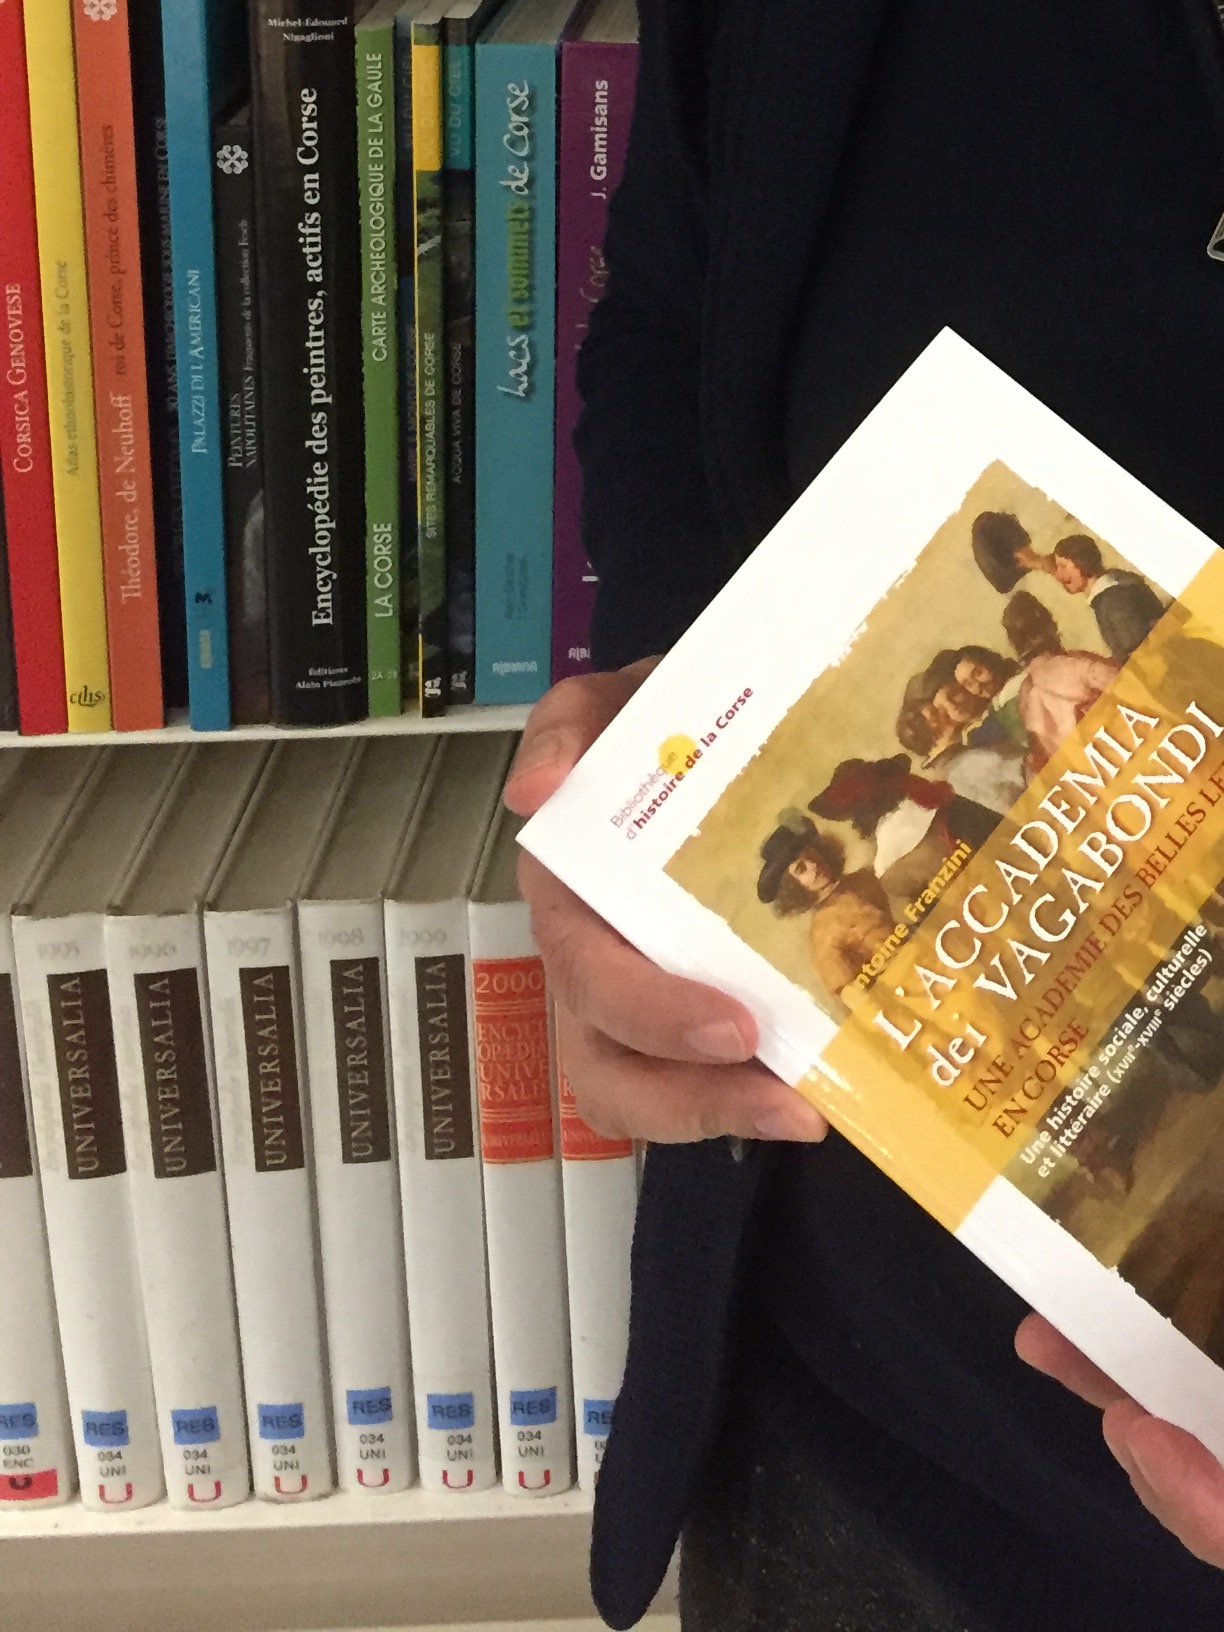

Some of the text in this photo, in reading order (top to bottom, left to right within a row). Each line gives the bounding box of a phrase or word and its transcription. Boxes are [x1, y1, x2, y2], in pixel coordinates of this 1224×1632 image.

[366, 53, 383, 109] GAULE
[367, 113, 383, 133] LA
[589, 79, 609, 200] J. Gamisans
[367, 138, 384, 158] DE
[496, 80, 530, 397] Lacs de Corse
[101, 199, 137, 502] de Neuhoff roi de prince des
[371, 311, 387, 362] CARTE
[296, 87, 337, 627] Encyclopédie des peintres, actifs en Corse
[451, 342, 462, 385] CORSE
[5, 283, 34, 473] CORSICA GENOVESE
[190, 374, 205, 391] DI
[451, 388, 462, 406] DE
[424, 332, 437, 539] SITES REMARQUABLES DE CORSE
[372, 523, 393, 617] LA CORSE
[626, 687, 754, 841] d'histoire de la Corse
[610, 751, 678, 829] Bibliothèque
[872, 703, 1160, 1052] L'ACCADEMIA
[903, 838, 972, 923] Franzini
[926, 700, 1224, 1088] dei VAGABONDI
[963, 1054, 1015, 1112] UNE
[1098, 885, 1143, 937] DES
[1134, 801, 1207, 890] BELLES
[476, 970, 543, 994] 2000
[342, 963, 373, 1158] UNIVERSALIA
[425, 961, 456, 1154] UNIVERSALIA
[1019, 923, 1208, 1165] Une histoire sociale, culturelle
[60, 976, 100, 1174] UNIVERSALIA
[148, 977, 187, 1173] UNIVERSALIA
[253, 972, 288, 1167] UNIVERSALIA
[991, 1017, 1090, 1139] EN CORSE
[1037, 948, 1214, 1178] et littéraire siècles)
[261, 1413, 301, 1429] RES
[352, 1398, 392, 1414] RES
[432, 1403, 472, 1419] RES
[513, 1398, 551, 1414] RES
[587, 1410, 612, 1425] RE
[86, 1422, 125, 1436] RES
[176, 1418, 215, 1433] RES
[359, 1433, 385, 1444] 034
[447, 1434, 473, 1445] 034
[518, 1430, 542, 1441] 034
[98, 1450, 123, 1461] 034
[183, 1449, 208, 1461] 034
[272, 1444, 296, 1455] 034
[273, 1459, 300, 1471] UNI
[359, 1448, 386, 1460] UNI
[447, 1449, 473, 1461] UNI
[518, 1445, 545, 1457] UNI
[100, 1464, 126, 1477] UNI
[185, 1463, 211, 1476] UNI
